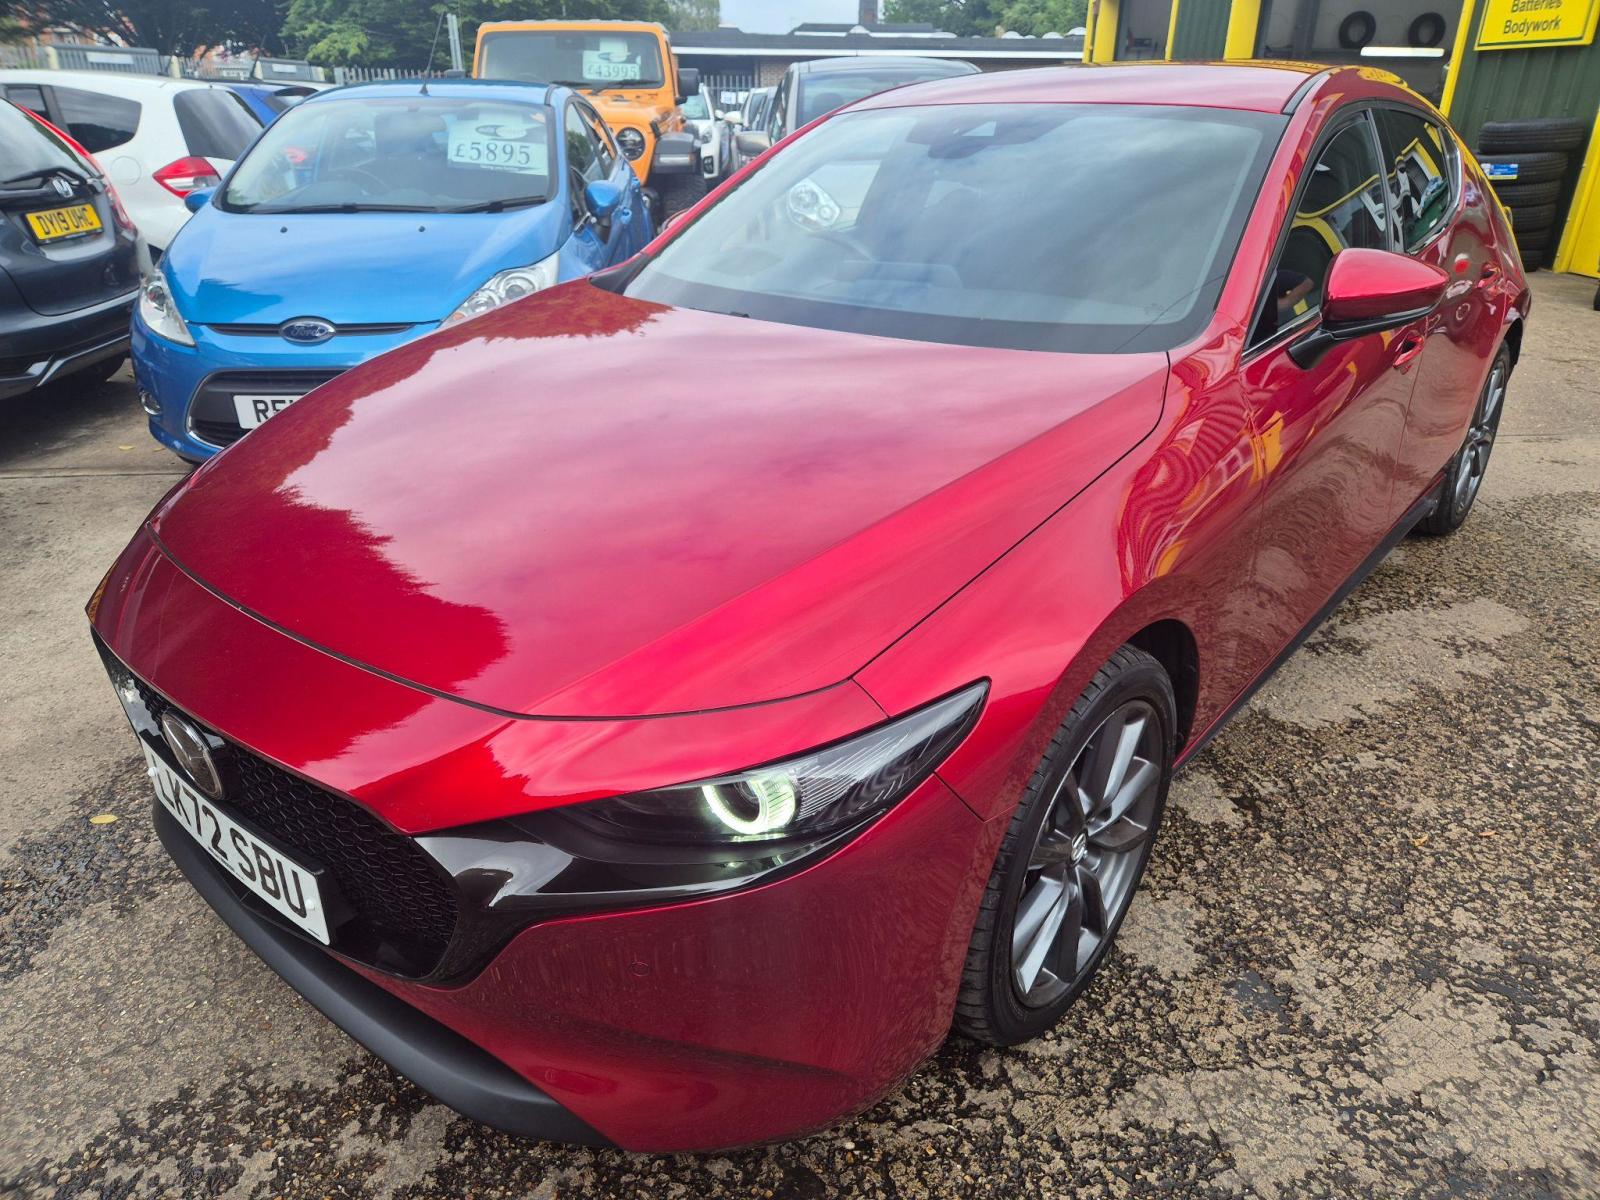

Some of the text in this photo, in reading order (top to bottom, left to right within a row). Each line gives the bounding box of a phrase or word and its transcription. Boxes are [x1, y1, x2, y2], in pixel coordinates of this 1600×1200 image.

[1511, 0, 1562, 12] Batteries
[1503, 15, 1561, 36] Bodywork
[455, 141, 530, 165] £5895
[36, 206, 94, 235] DY19 UHC
[290, 323, 327, 337] Ford
[151, 754, 307, 918] LK72 SBU
